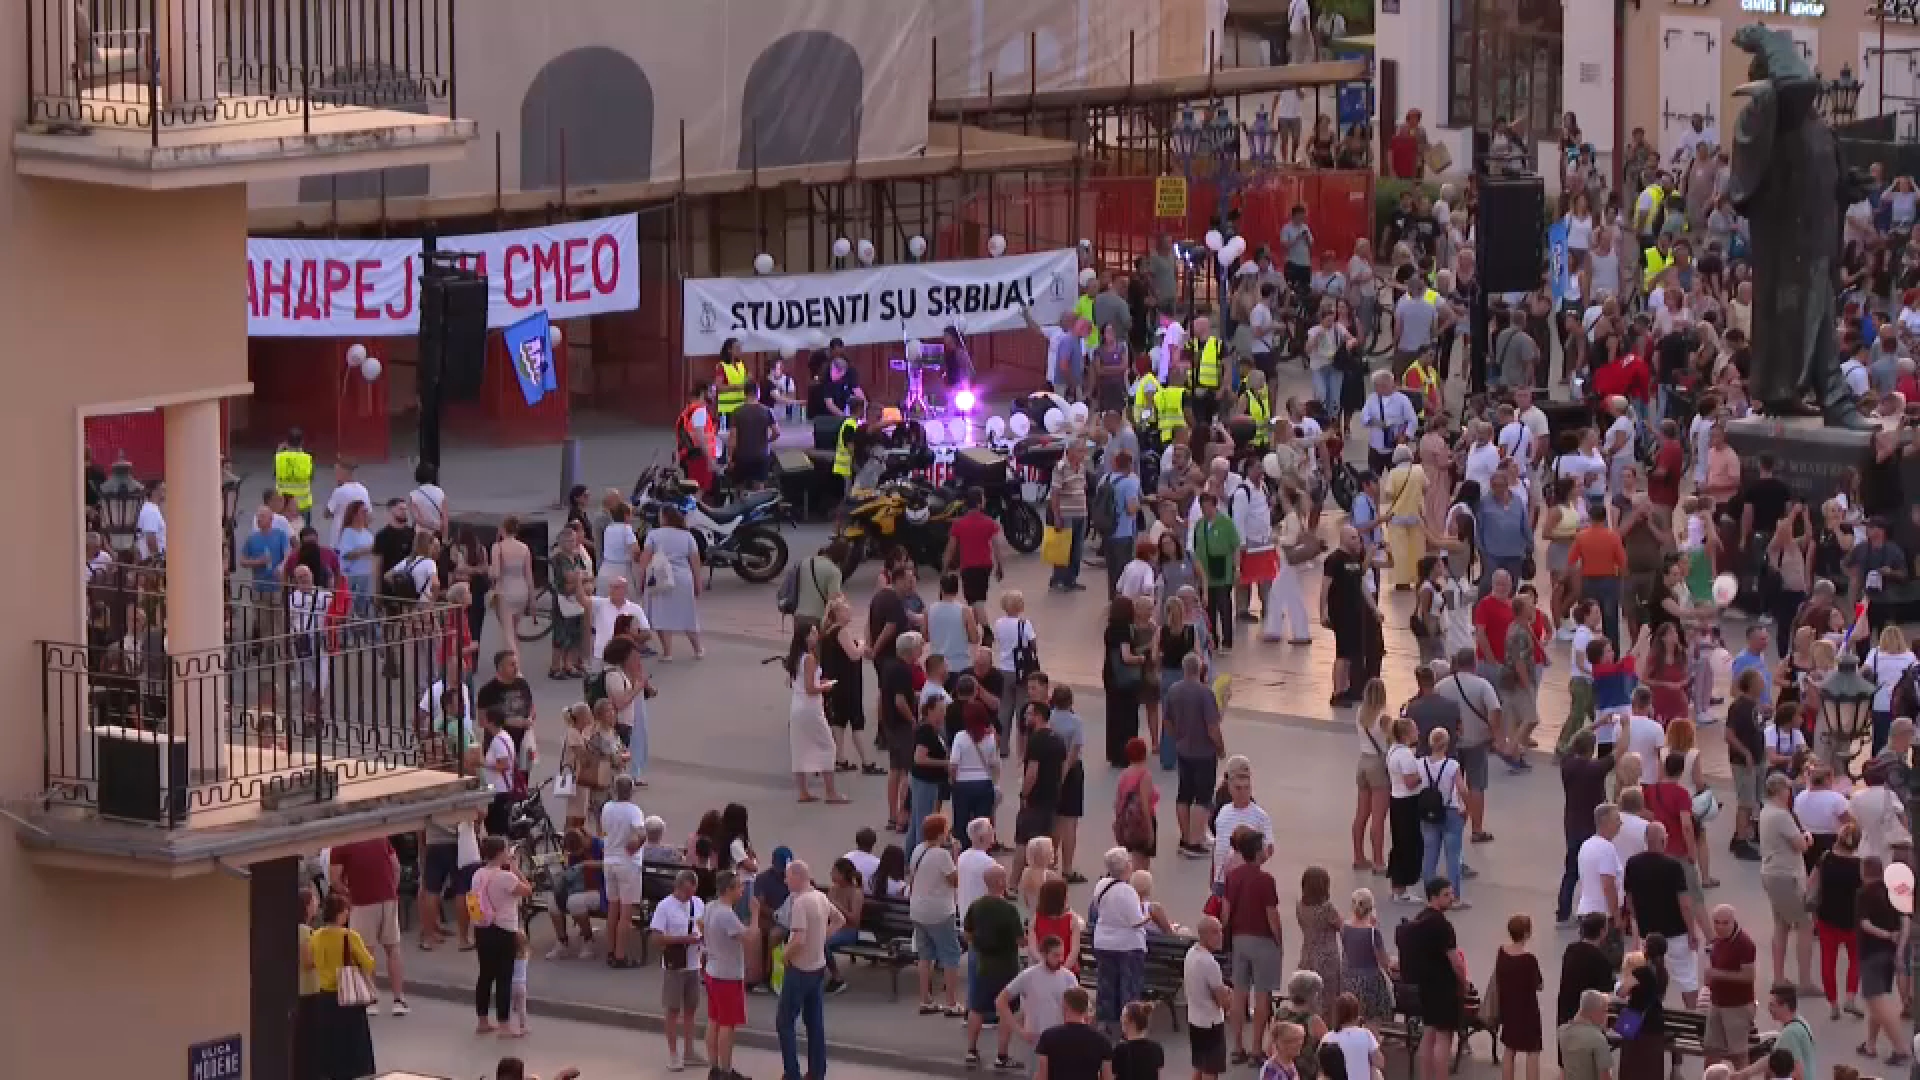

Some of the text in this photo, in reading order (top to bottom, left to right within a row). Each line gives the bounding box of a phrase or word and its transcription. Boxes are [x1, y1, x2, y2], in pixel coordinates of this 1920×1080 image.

[503, 234, 620, 308] СМЕО
[731, 276, 1034, 331] STUDENTI SU SRBIJA!
